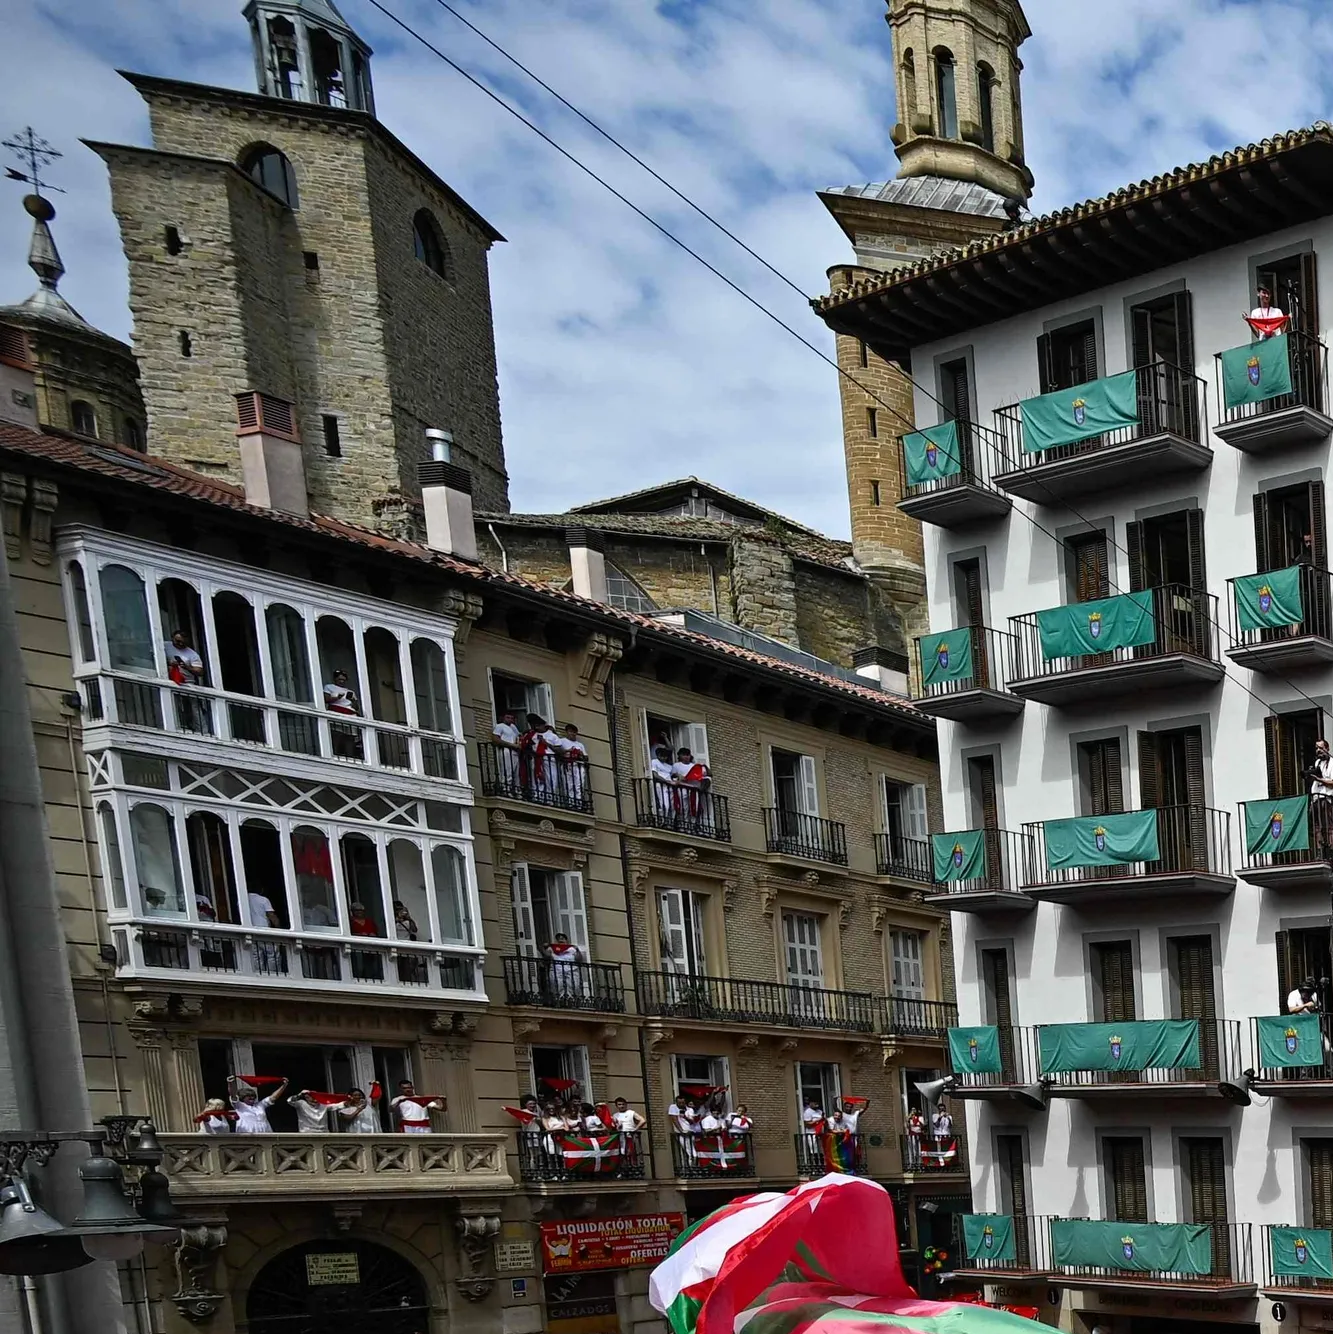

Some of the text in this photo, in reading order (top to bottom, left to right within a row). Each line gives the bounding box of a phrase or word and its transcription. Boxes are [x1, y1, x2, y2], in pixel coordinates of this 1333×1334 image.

[557, 1217, 670, 1235] LIQUIDACIÓN TOTAL
[630, 1248, 669, 1258] OFERTAS
[552, 1304, 610, 1318] CALZADOS
